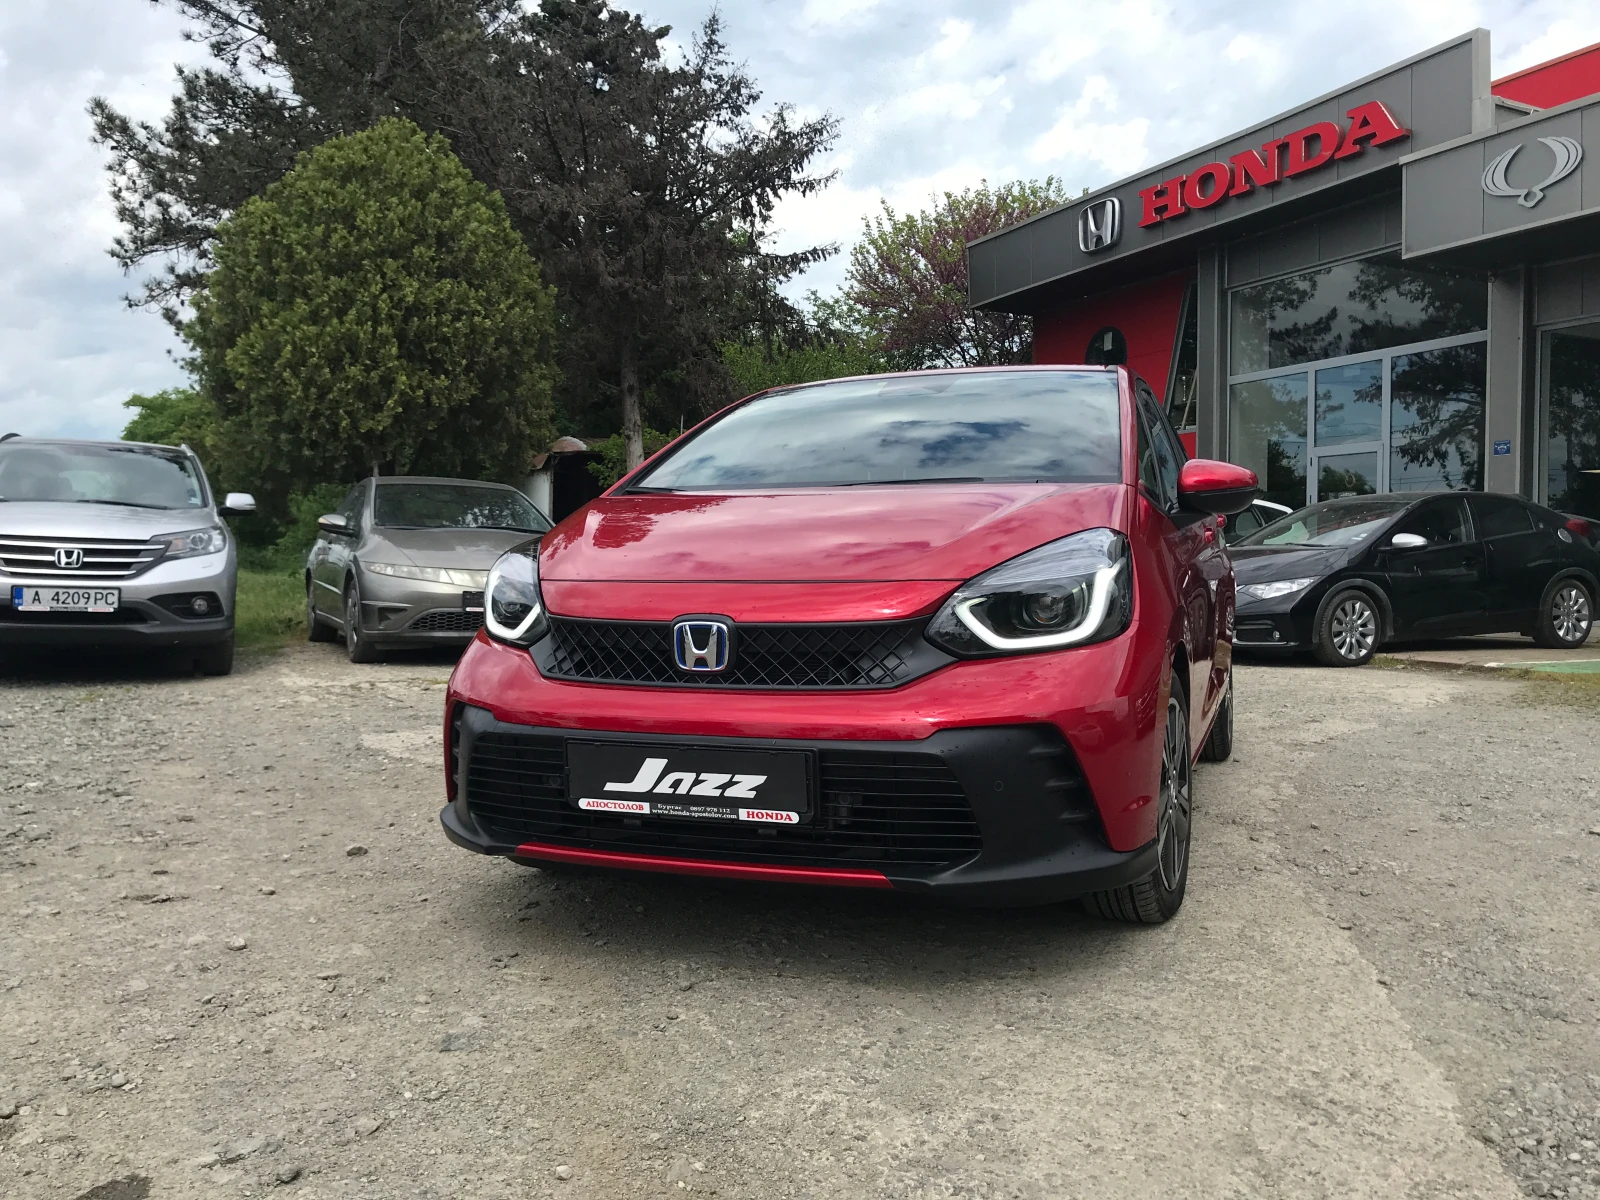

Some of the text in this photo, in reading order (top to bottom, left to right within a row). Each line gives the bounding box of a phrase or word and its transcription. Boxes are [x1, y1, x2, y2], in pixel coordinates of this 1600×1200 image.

[1138, 100, 1412, 229] HONDA
[32, 590, 42, 604] A
[586, 800, 645, 811] АПОСТОЛОВ
[746, 810, 793, 822] HONDA
